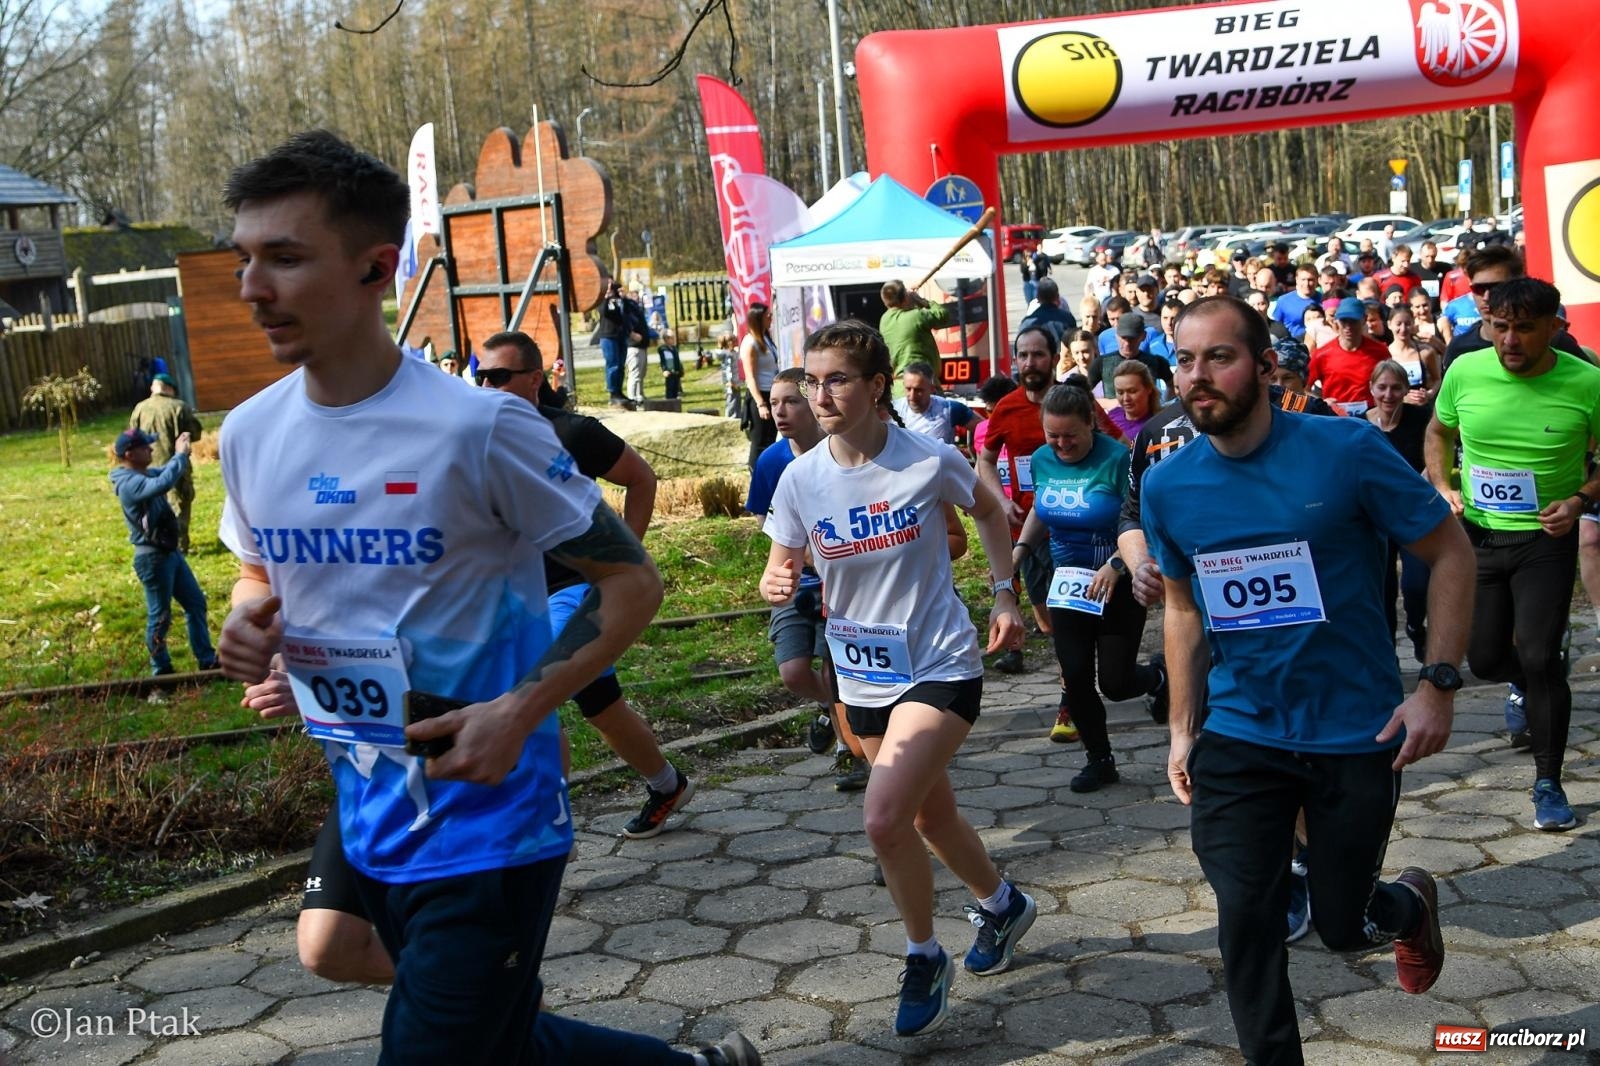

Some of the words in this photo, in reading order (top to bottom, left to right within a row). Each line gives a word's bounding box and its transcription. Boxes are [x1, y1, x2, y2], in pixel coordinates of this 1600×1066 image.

[1214, 9, 1300, 35] BIEG
[1146, 35, 1380, 82] TWARDZIELA
[1169, 76, 1357, 118] RACIBÓRZ
[945, 361, 970, 380] 08
[1481, 483, 1523, 501] 062
[869, 500, 890, 515] UKS
[849, 506, 871, 539] 5
[870, 506, 918, 536] PLUS
[1202, 560, 1217, 568] XIV
[1220, 556, 1242, 566] BIEG
[1244, 549, 1302, 563] TWARDZIELA
[1222, 573, 1297, 609] 095
[327, 647, 392, 658] TWARDZIELA
[845, 643, 892, 669] 015
[311, 675, 389, 718] 039
